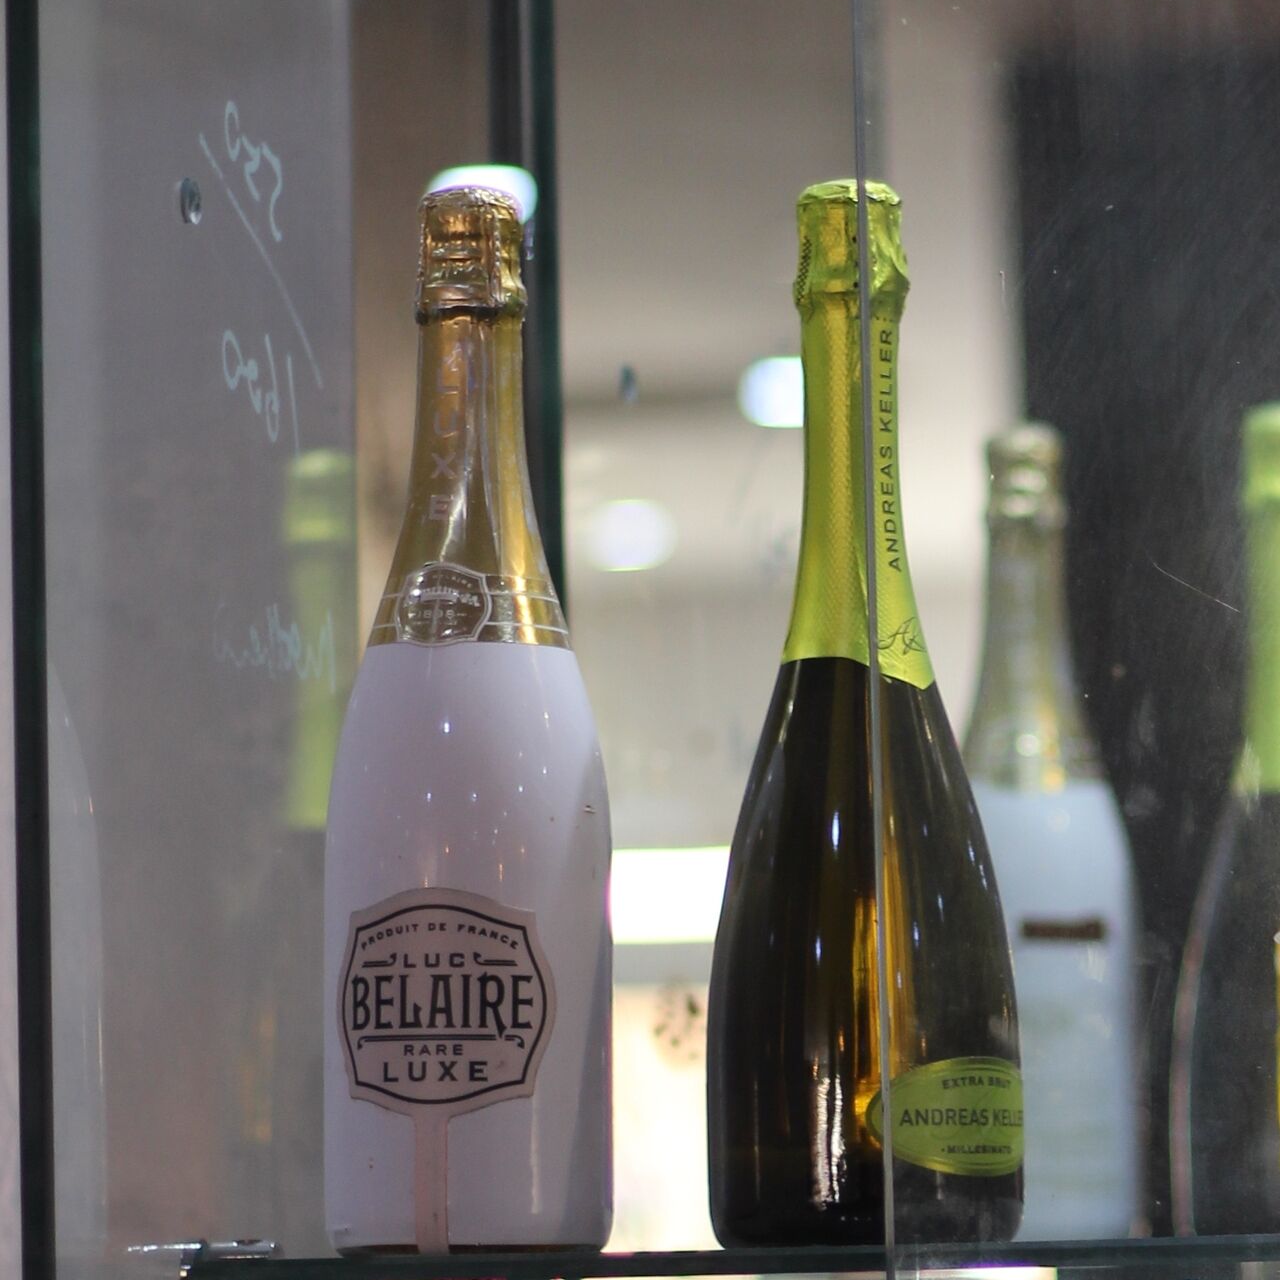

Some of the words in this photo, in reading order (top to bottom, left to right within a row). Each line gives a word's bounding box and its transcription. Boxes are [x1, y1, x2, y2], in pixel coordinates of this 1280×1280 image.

[879, 329, 893, 434] KELLER
[880, 445, 902, 573] ANDREAS
[361, 924, 418, 950] PRODUIT
[428, 922, 447, 931] DE
[457, 924, 519, 949] FRANCE
[404, 953, 465, 968] LUC
[351, 971, 533, 1039] BELAIRE
[404, 1044, 463, 1056] RARE
[383, 1061, 488, 1082] LUXE
[942, 1076, 985, 1089] EXTRA
[900, 1108, 989, 1127] ANDREAS
